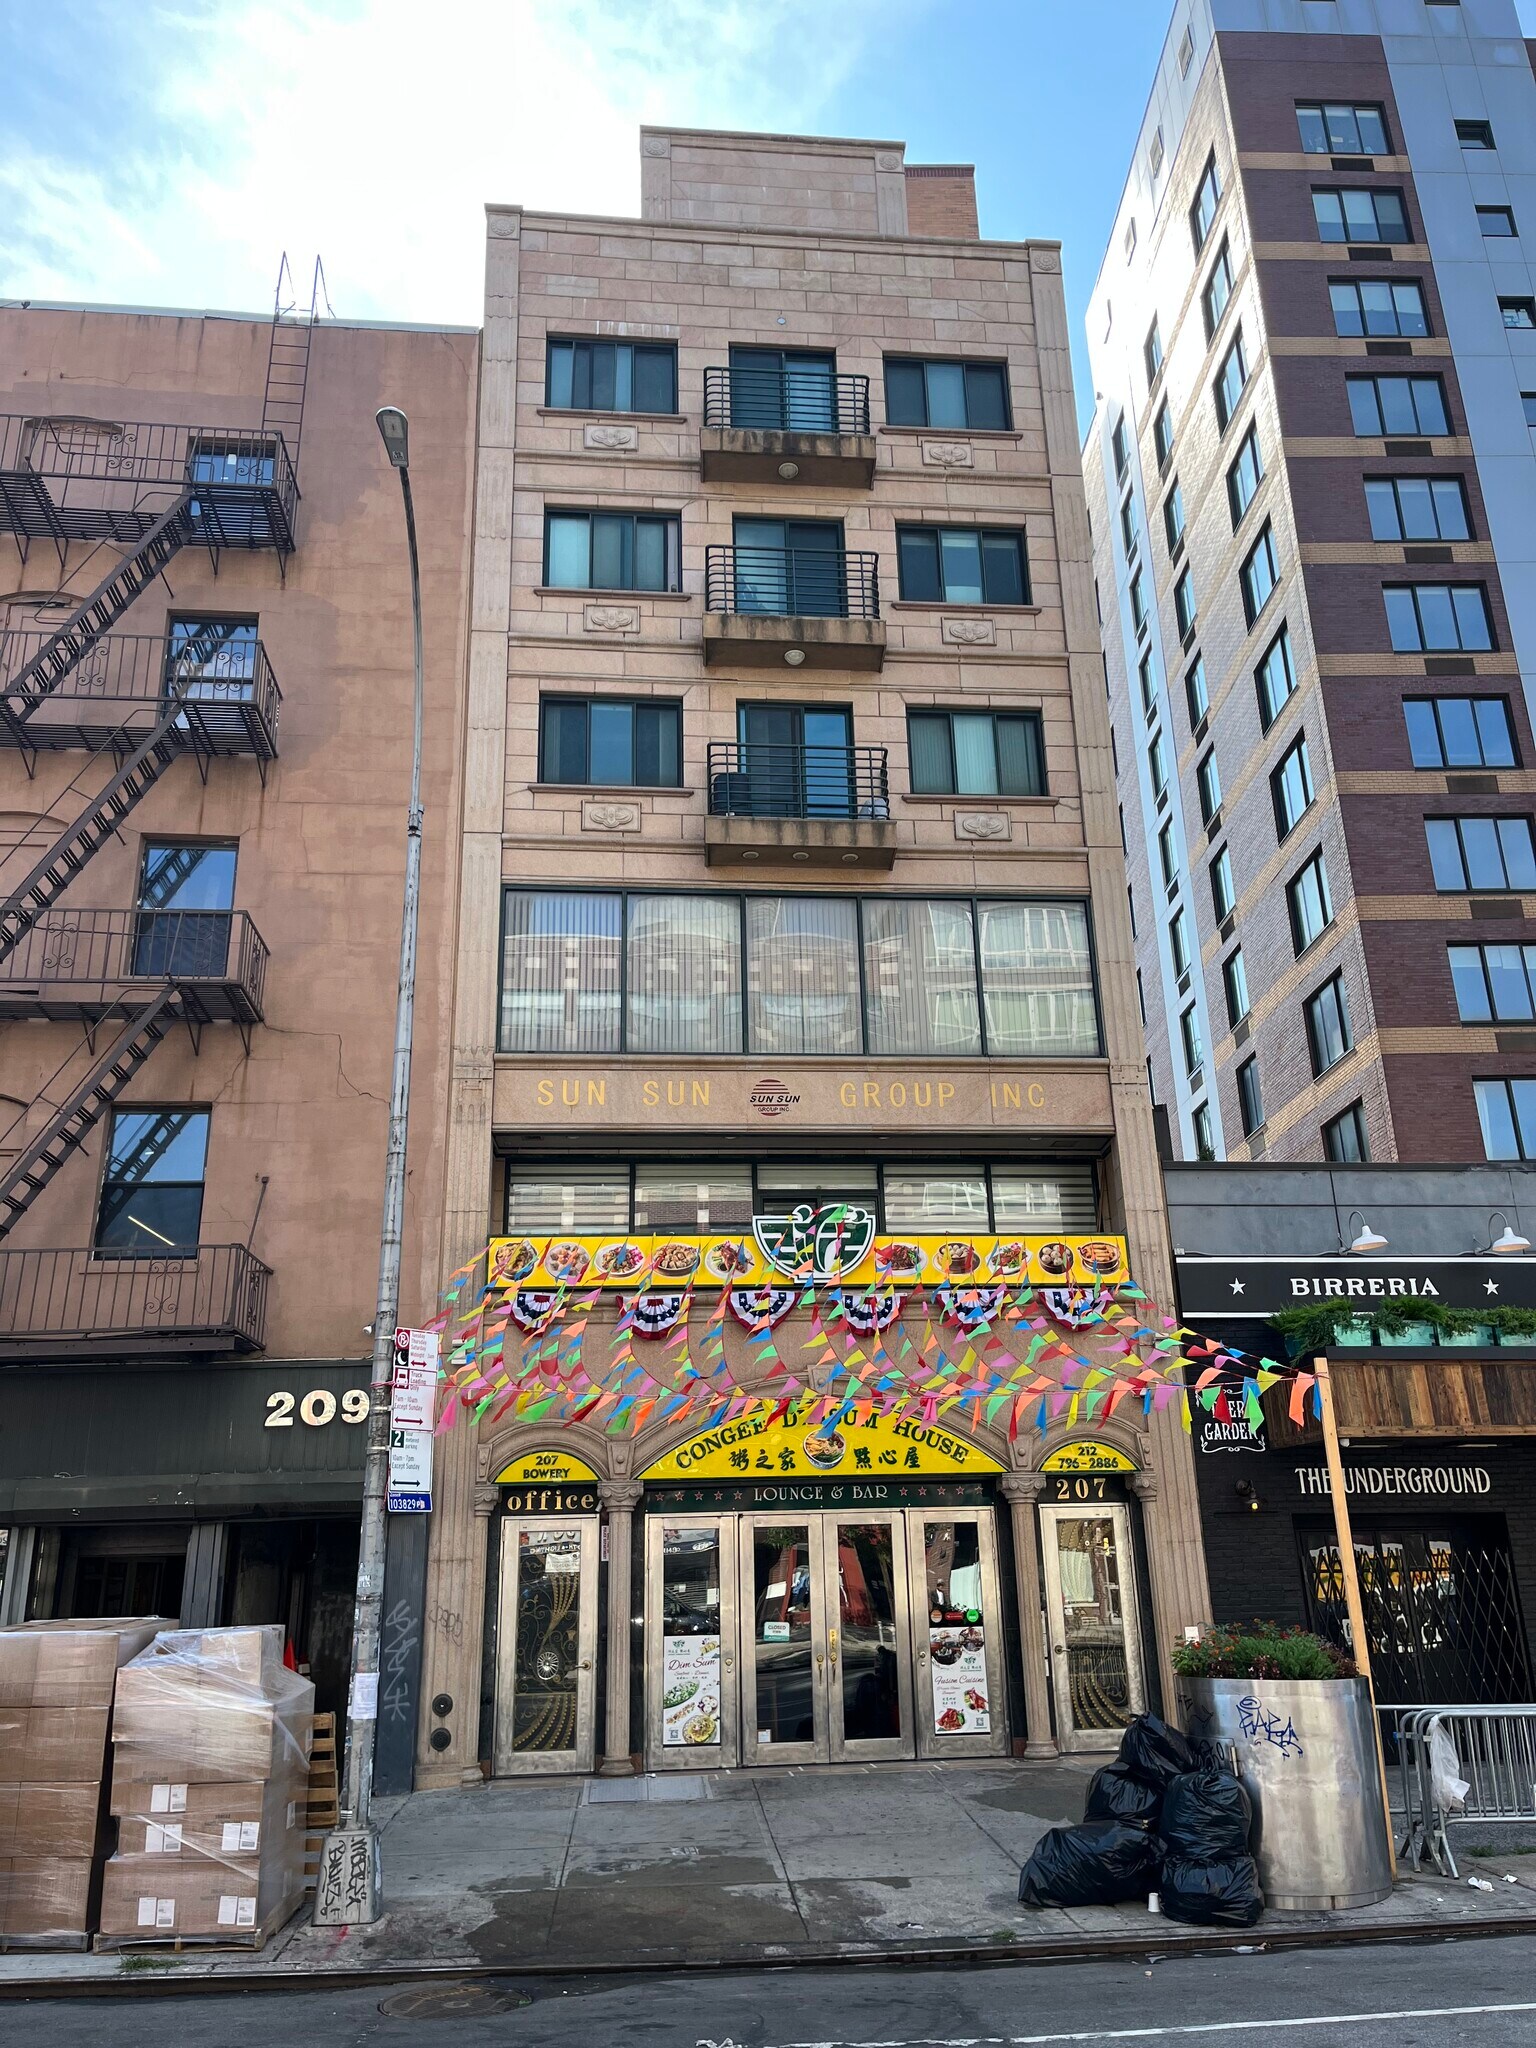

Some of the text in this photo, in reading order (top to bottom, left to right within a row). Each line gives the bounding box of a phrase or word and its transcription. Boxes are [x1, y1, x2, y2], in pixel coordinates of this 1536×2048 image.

[537, 1079, 710, 1106] SUN SUN
[750, 1095, 801, 1103] SUN SUN
[840, 1081, 955, 1108] GROUP
[1290, 1277, 1440, 1296] BIRRERIA
[410, 1384, 420, 1392] Only
[264, 1389, 370, 1427] 209
[394, 1403, 408, 1411] Except
[1212, 1400, 1246, 1418] ER
[393, 1431, 402, 1447] 2
[892, 1417, 970, 1464] HOUSE
[406, 1455, 415, 1463] 7pm
[728, 1447, 796, 1471] 粥之家
[853, 1446, 921, 1469] 點心屋
[1078, 1446, 1097, 1456] 212
[391, 1462, 420, 1471] Except Sunday
[535, 1455, 559, 1466] 207
[523, 1468, 571, 1479] BOWERY
[1294, 1467, 1492, 1495] THE UNDERGROUND
[753, 1485, 889, 1501] LOUNGE & BAR
[1056, 1477, 1106, 1499] 207
[390, 1498, 416, 1509] 103829
[507, 1489, 594, 1511] office
[668, 1656, 716, 1670] Dim Sum
[935, 1675, 985, 1685] Fusion Cuisine
